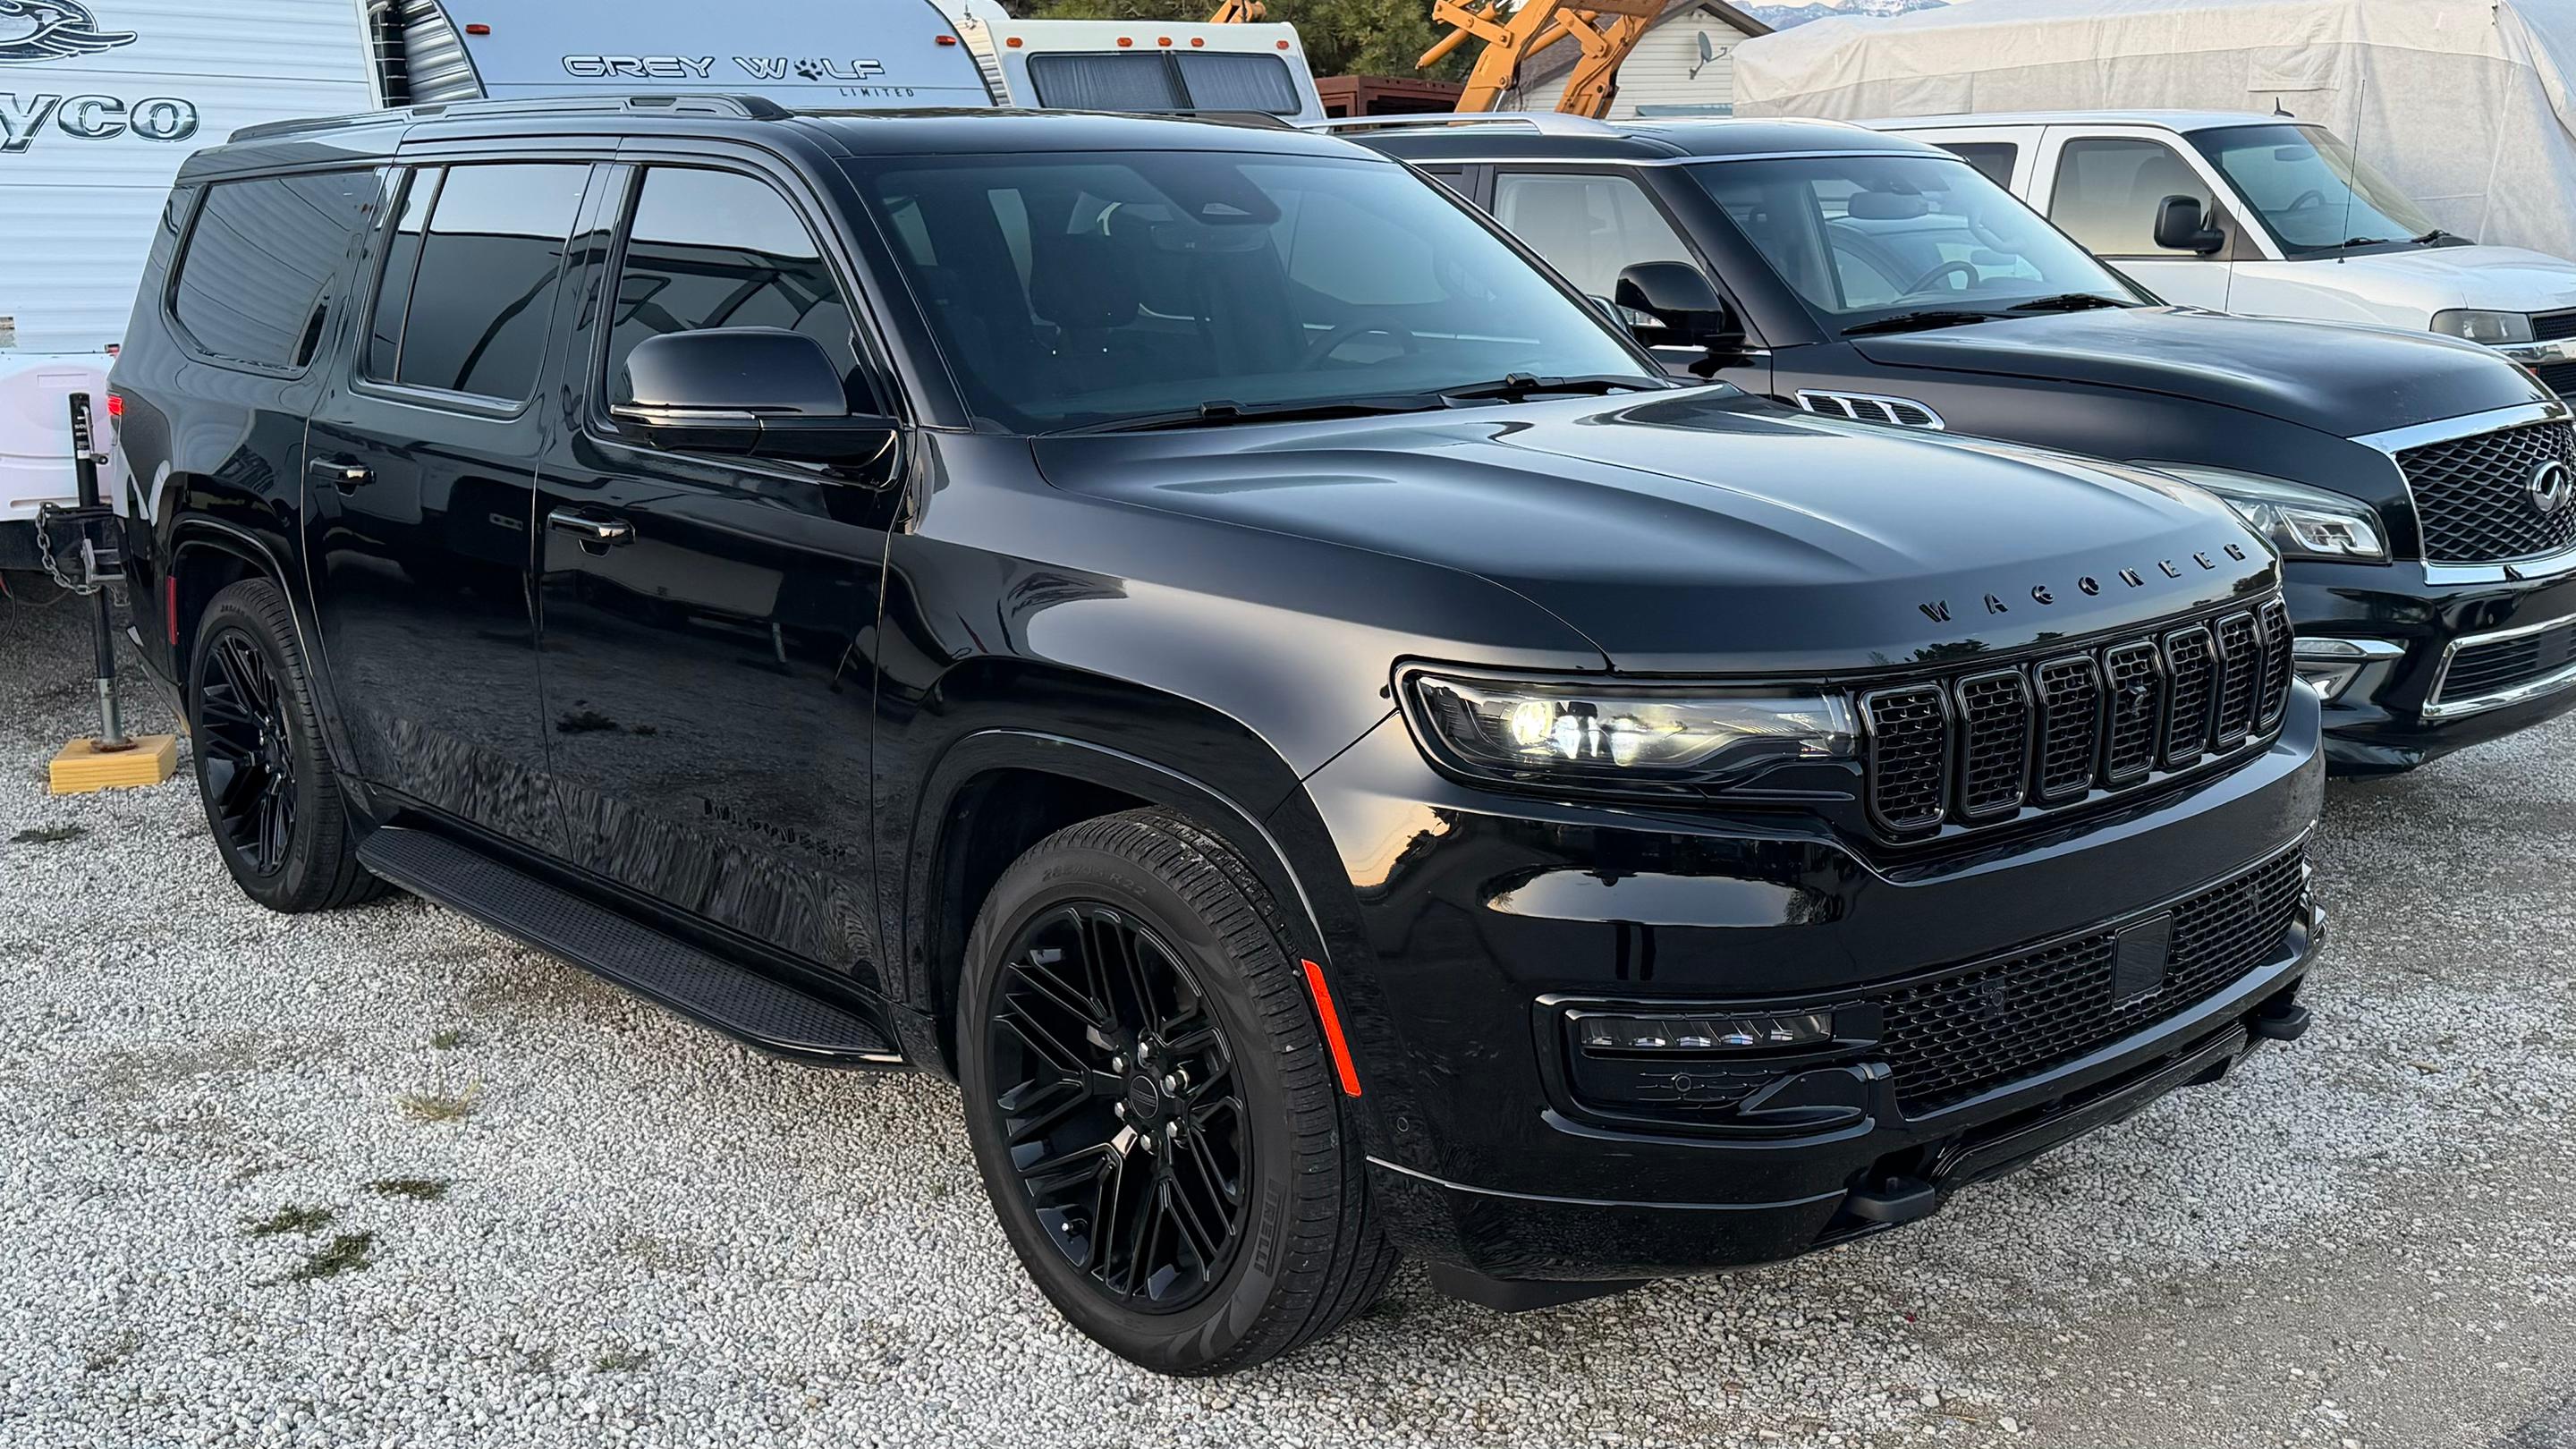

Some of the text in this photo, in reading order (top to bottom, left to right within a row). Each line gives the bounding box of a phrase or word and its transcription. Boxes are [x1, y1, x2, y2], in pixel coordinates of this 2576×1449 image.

[562, 55, 716, 79] GREY
[838, 88, 915, 97] LIMITED
[1919, 542, 2246, 624] WAGONEER
